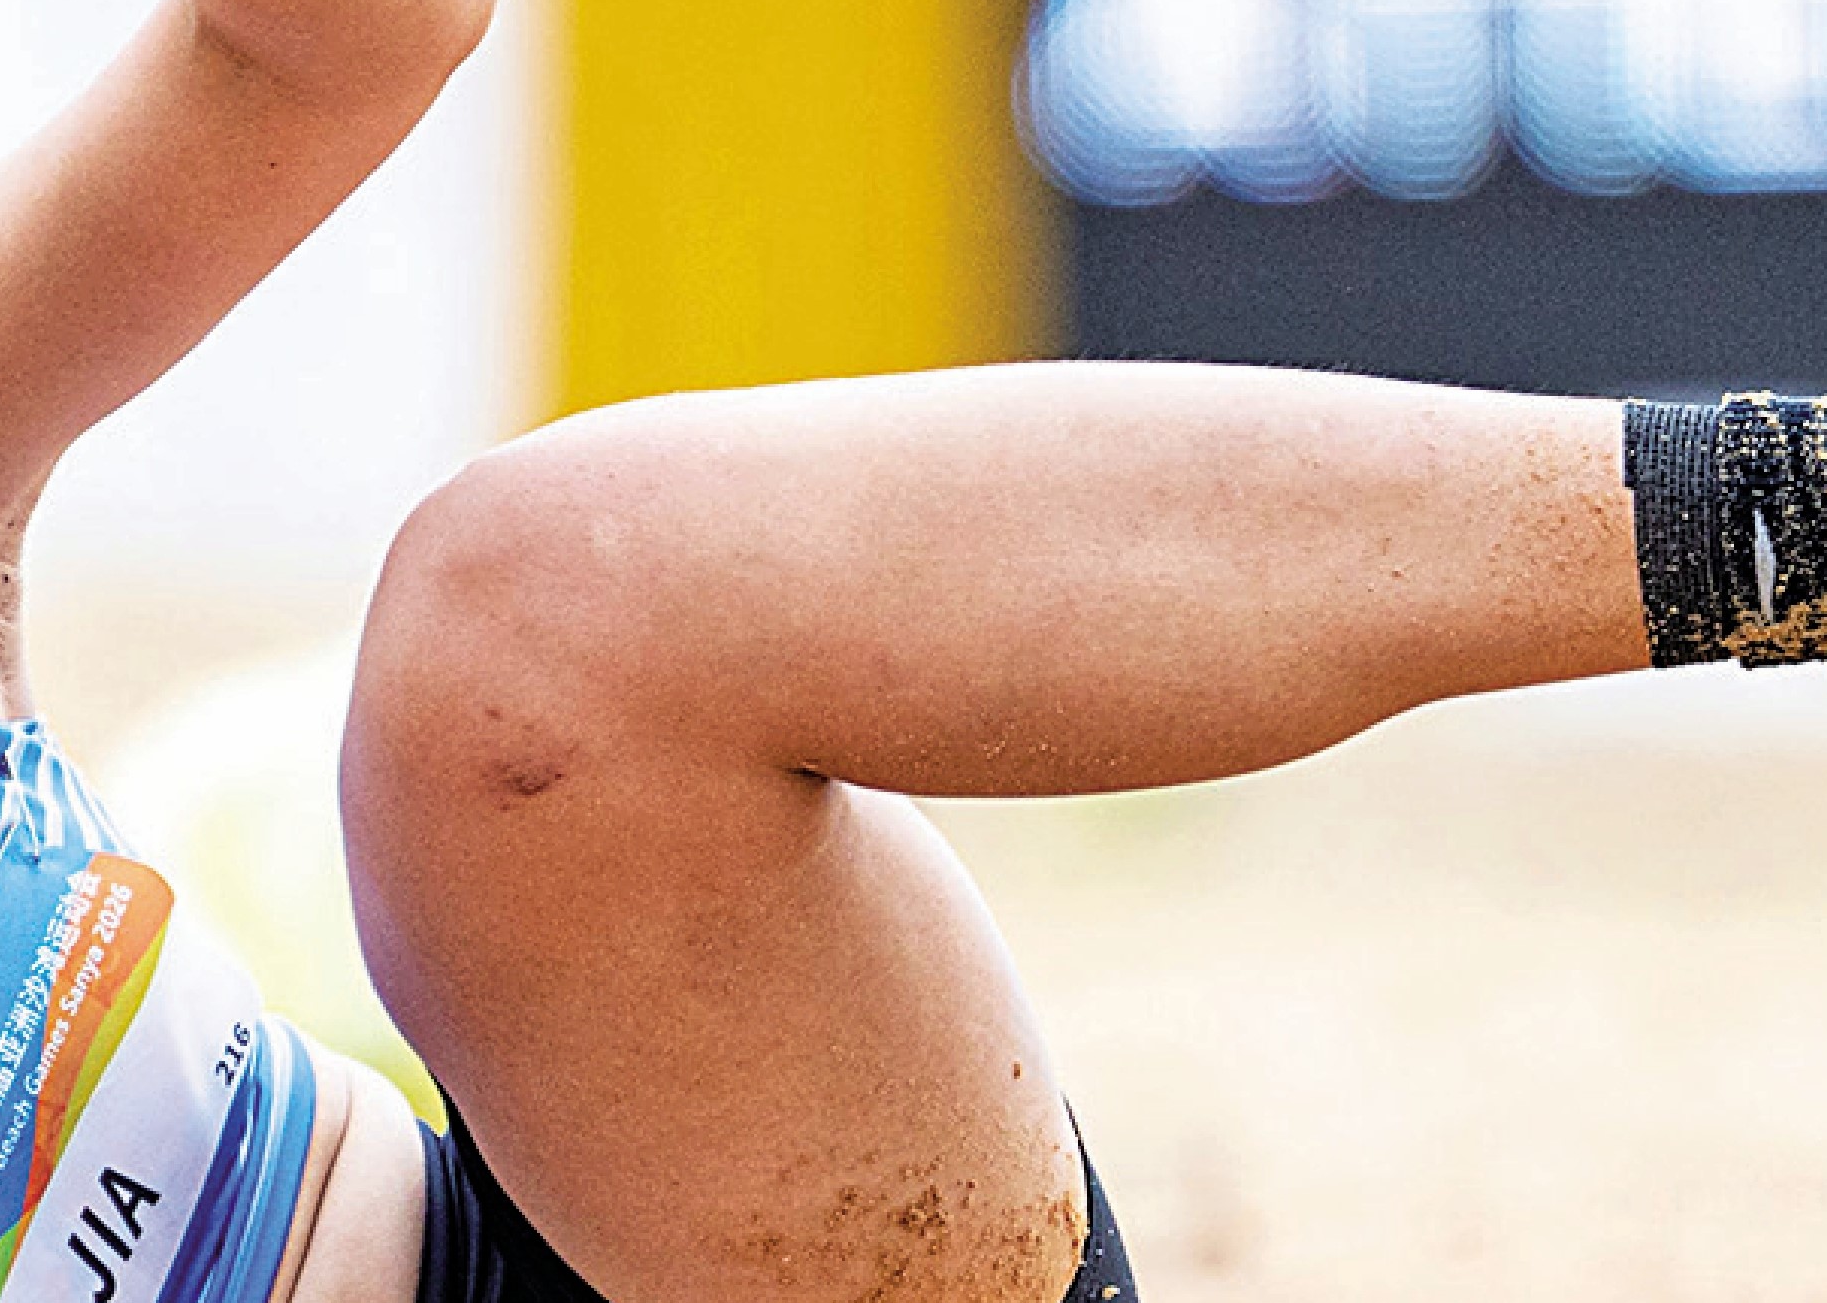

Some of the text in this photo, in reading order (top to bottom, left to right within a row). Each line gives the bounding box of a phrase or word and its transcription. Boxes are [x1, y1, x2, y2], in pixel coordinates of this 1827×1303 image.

[24, 1018, 70, 1095] Games
[59, 945, 105, 1017] Sanya
[91, 882, 133, 944] 2026
[216, 1021, 251, 1088] 216
